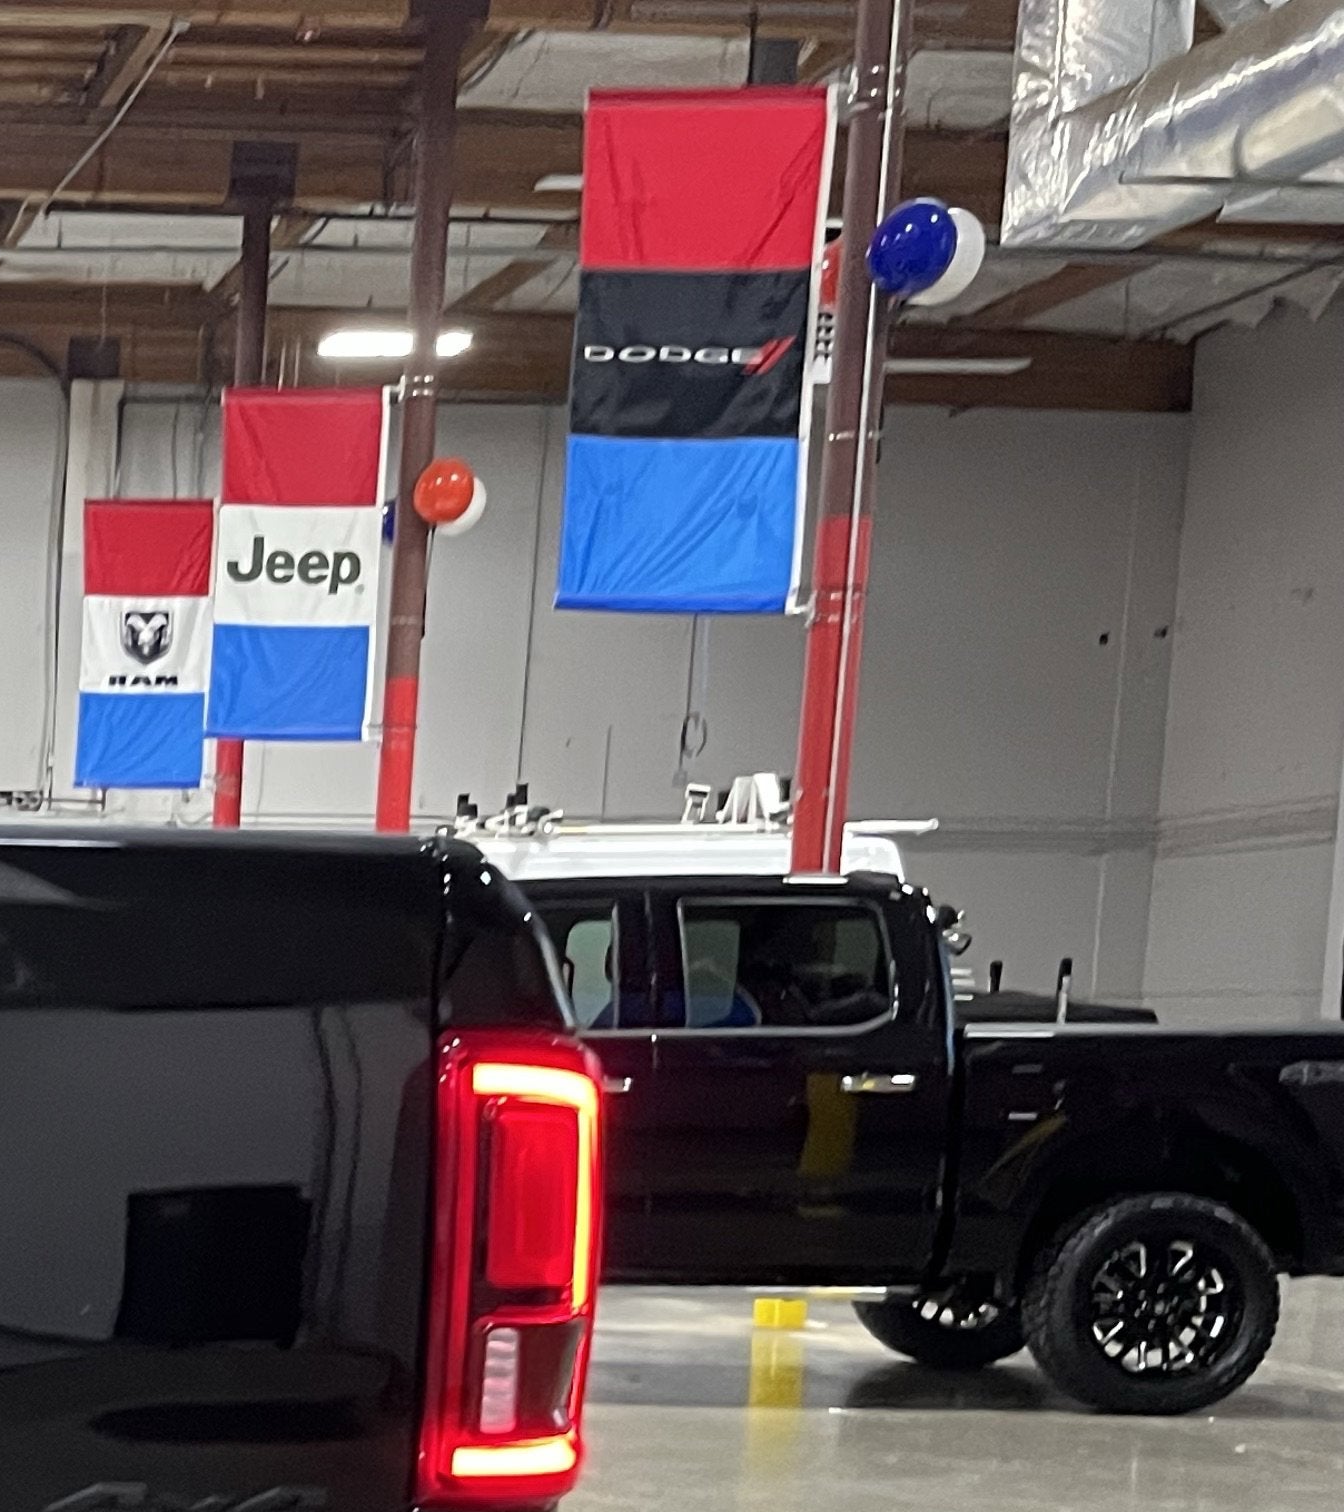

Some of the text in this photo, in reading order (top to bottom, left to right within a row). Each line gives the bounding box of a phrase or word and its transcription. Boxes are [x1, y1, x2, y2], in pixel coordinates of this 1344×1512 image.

[584, 345, 762, 364] DODGE
[226, 536, 362, 595] Jeep
[108, 675, 179, 686] RAM
